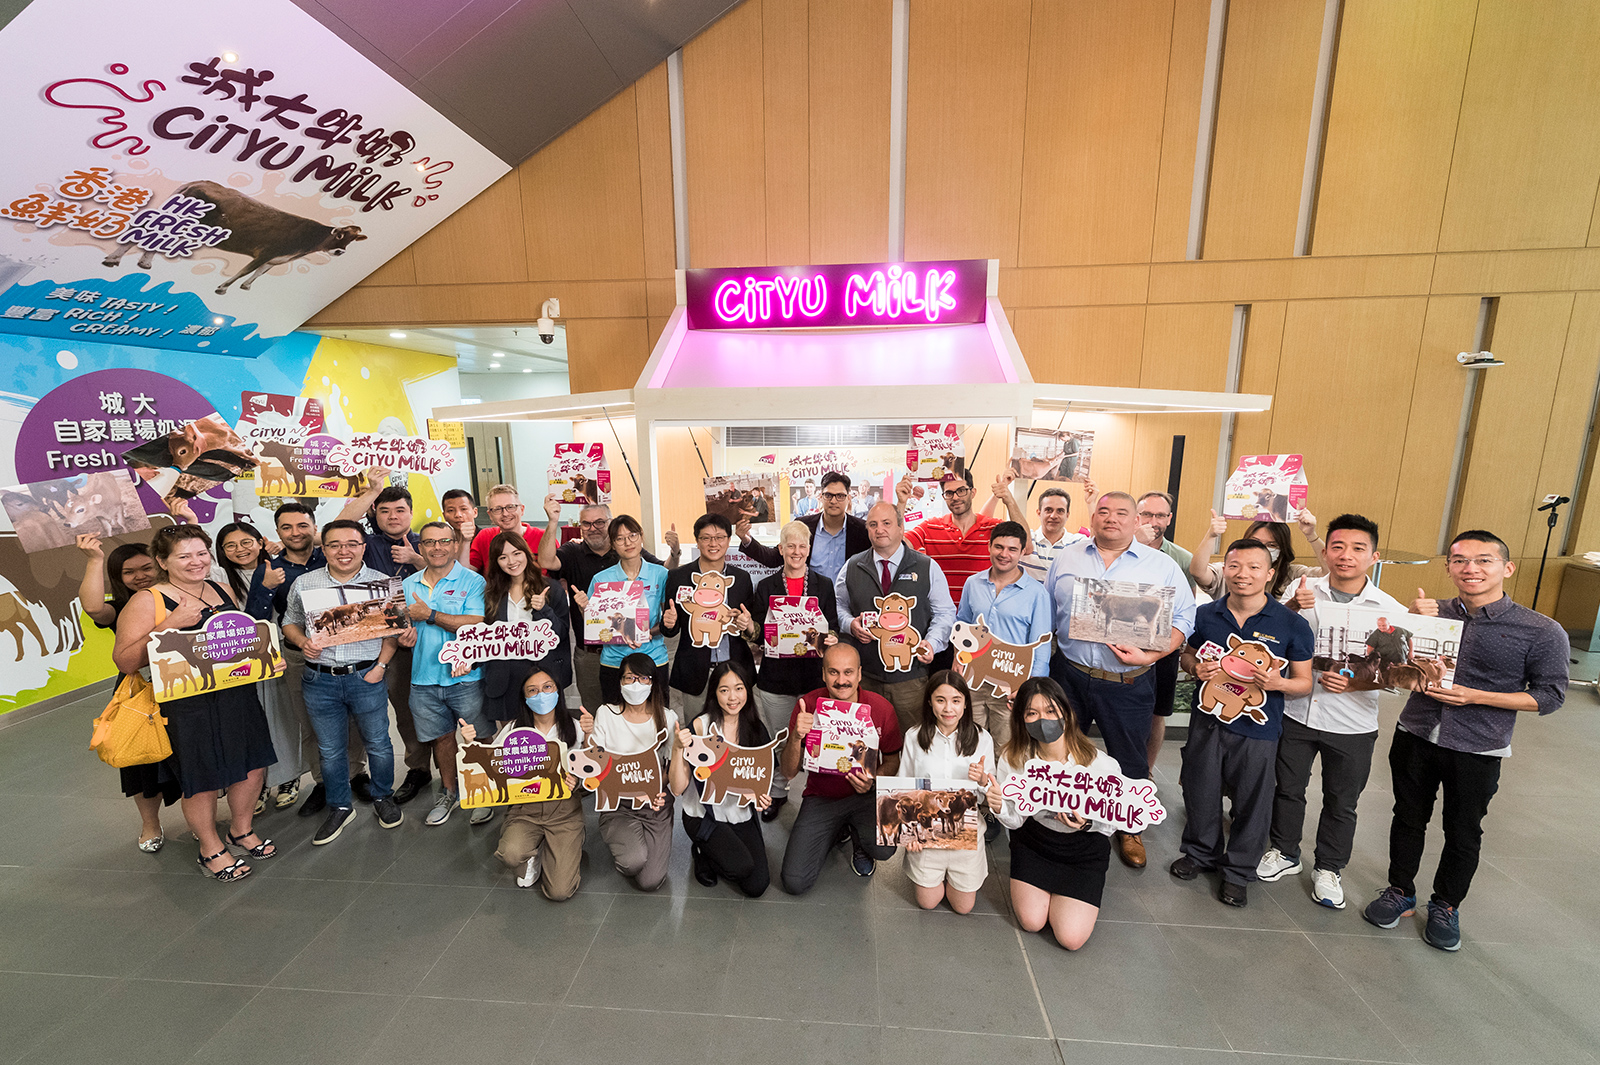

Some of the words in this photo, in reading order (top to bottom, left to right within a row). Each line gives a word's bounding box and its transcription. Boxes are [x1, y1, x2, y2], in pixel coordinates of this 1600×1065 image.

[60, 167, 150, 211] 香港
[162, 196, 214, 217] HK
[1, 194, 131, 236] 鮮奶
[134, 210, 228, 245] FRESH
[45, 287, 102, 303] 美味
[46, 448, 117, 469] Fresh
[297, 464, 321, 472] CityU
[213, 619, 235, 629] 城大
[196, 625, 255, 643] 自家農場奶源
[192, 643, 219, 653] Fresh
[221, 639, 240, 650] milk
[240, 635, 261, 646] from
[202, 649, 229, 661] CityU
[231, 645, 255, 655] Farm
[509, 736, 529, 745] 城大
[493, 744, 546, 757] 自家農場奶源
[490, 758, 514, 767] Fresh
[515, 755, 531, 764] milk
[532, 754, 551, 762] from
[498, 765, 521, 775] CityU
[523, 764, 545, 772] Farm
